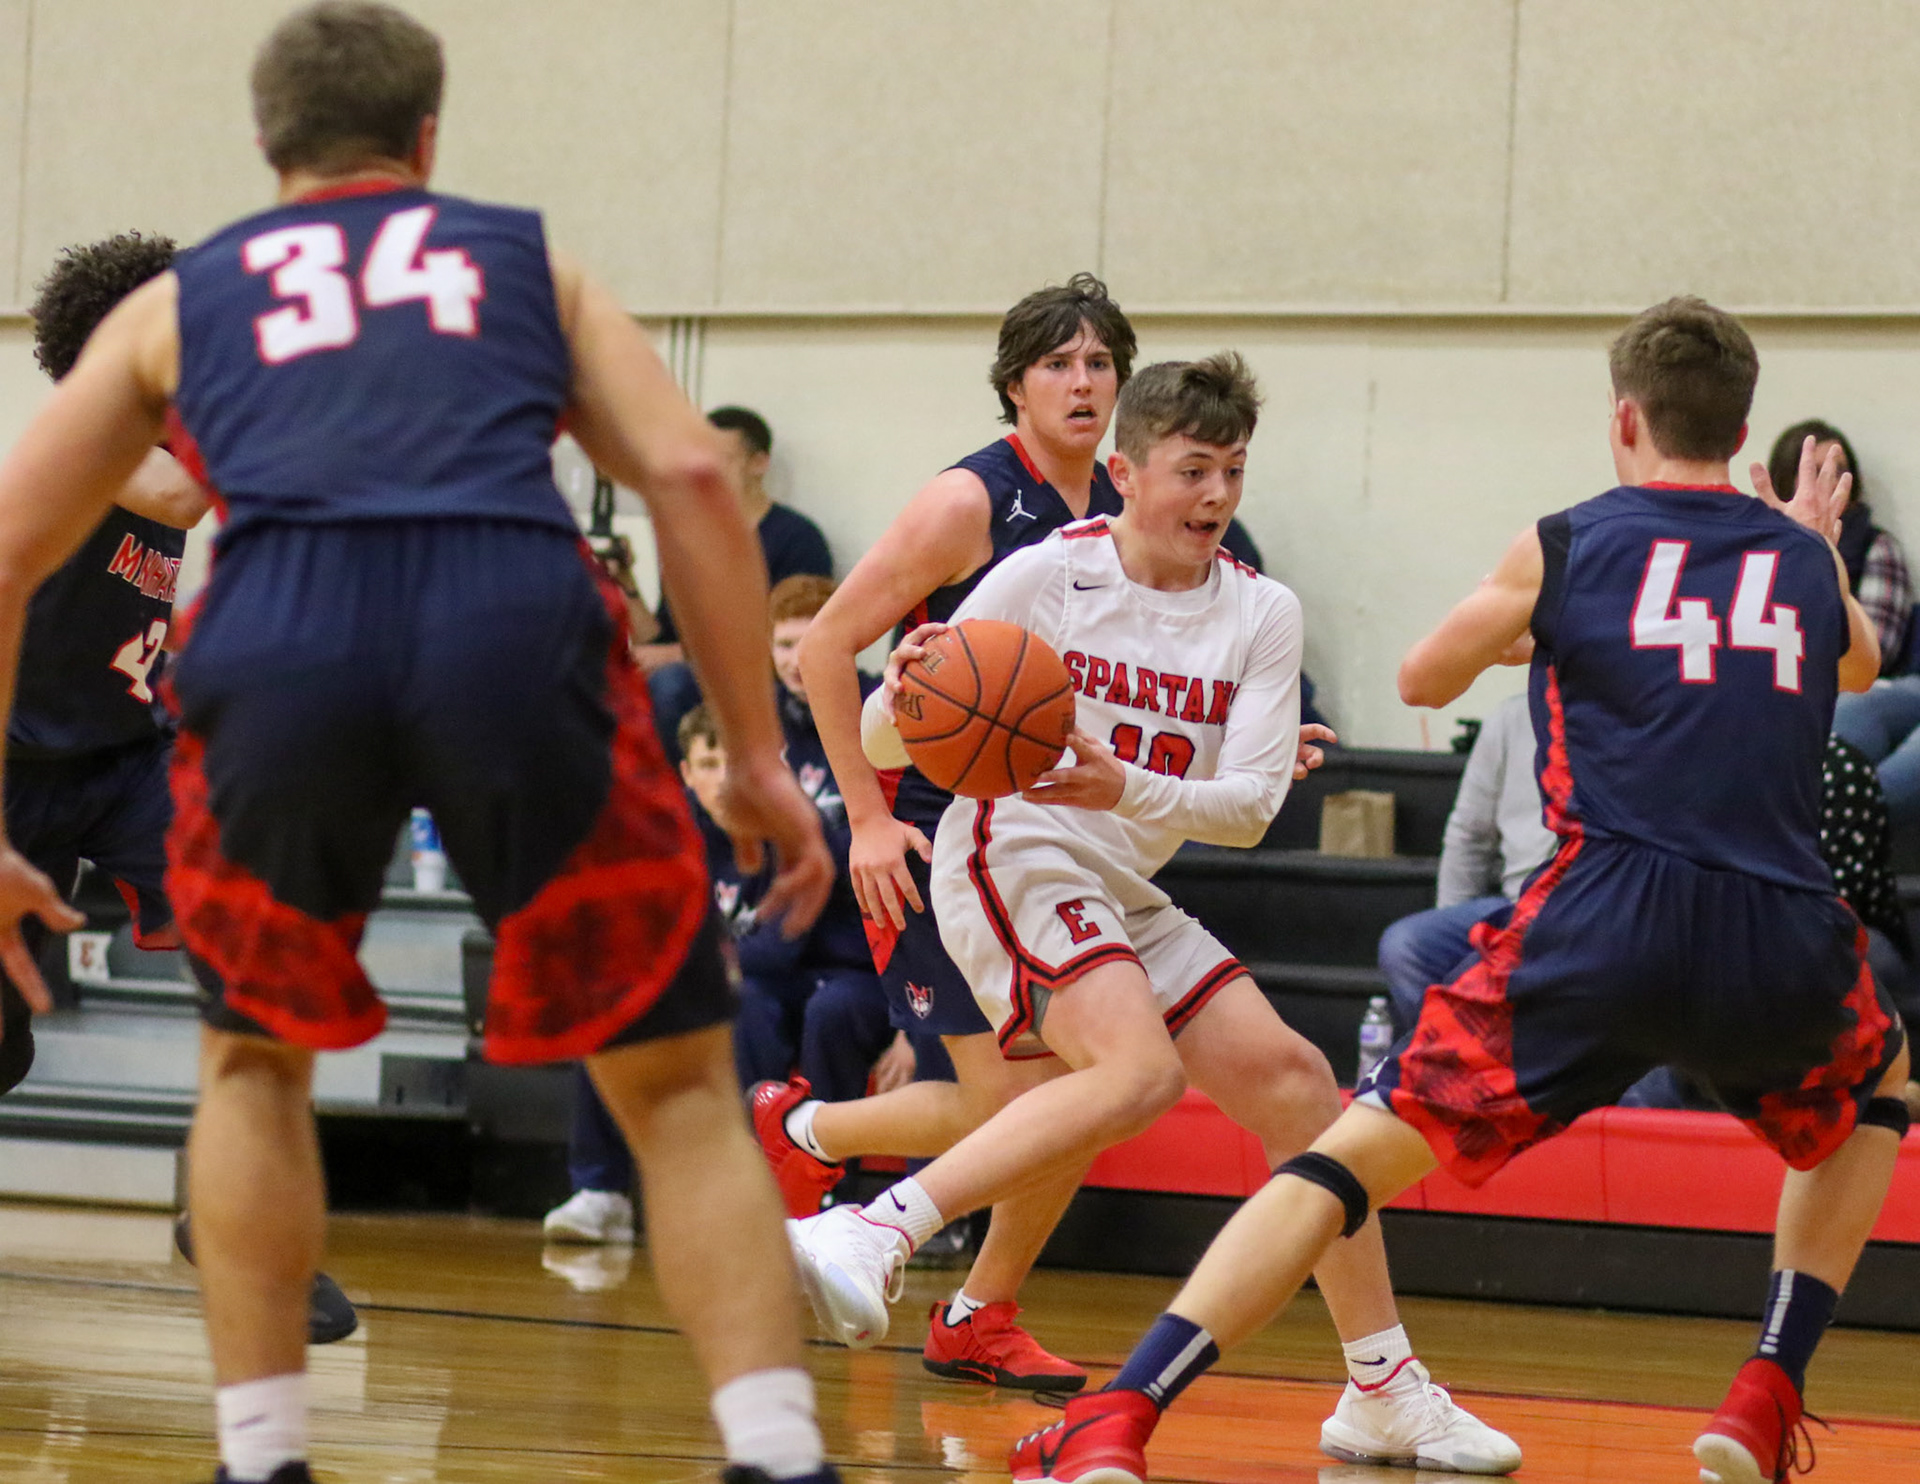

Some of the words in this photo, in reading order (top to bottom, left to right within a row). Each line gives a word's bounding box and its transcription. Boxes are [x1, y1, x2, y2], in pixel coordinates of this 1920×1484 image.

[241, 204, 486, 366] 34
[1629, 537, 1807, 695] 44
[1063, 650, 1241, 726] SPARTAN
[1056, 898, 1102, 946] E
